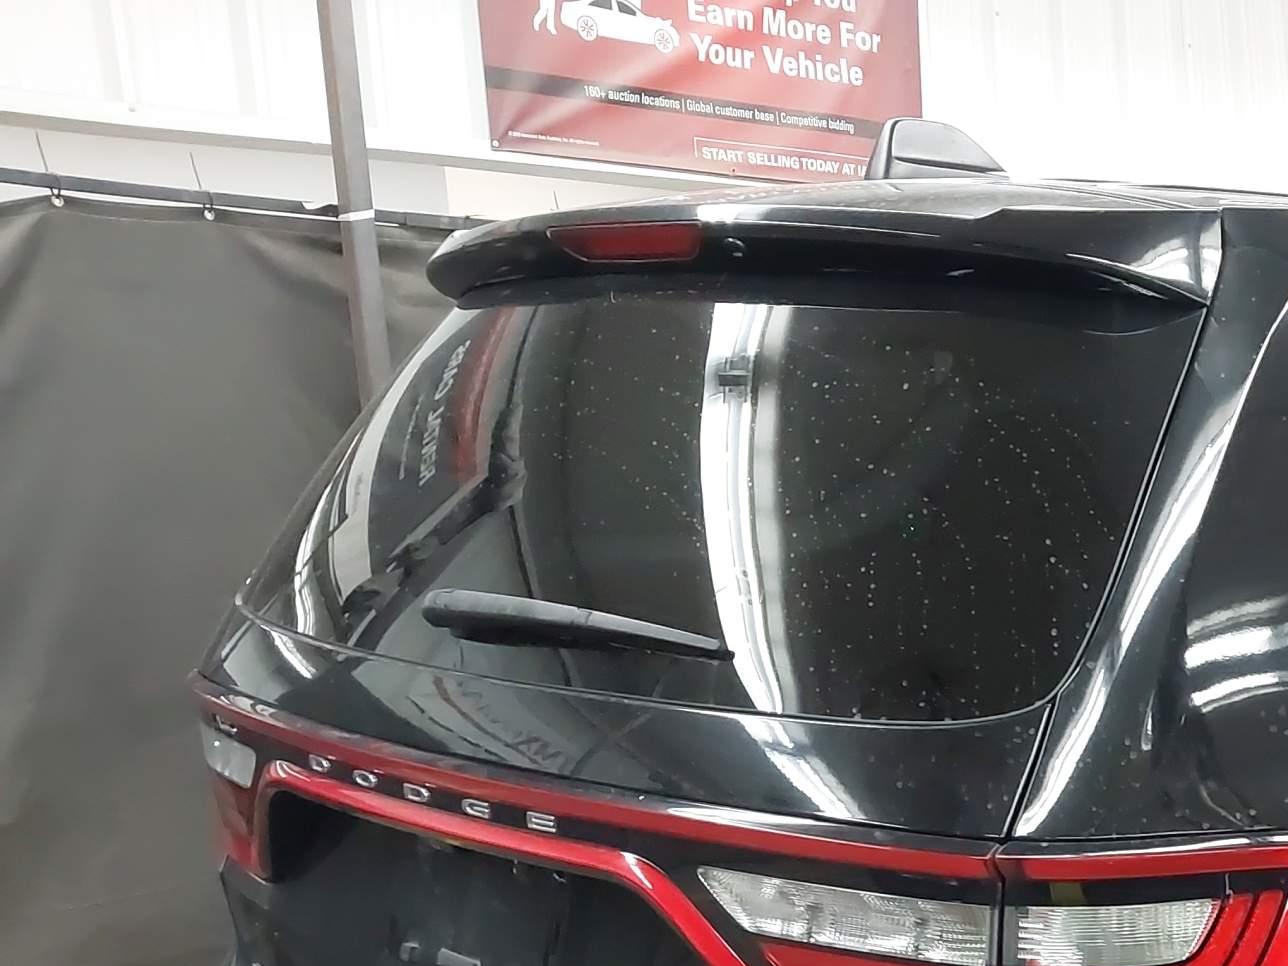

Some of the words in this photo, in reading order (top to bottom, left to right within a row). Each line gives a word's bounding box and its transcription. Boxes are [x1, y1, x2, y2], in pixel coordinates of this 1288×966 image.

[687, 0, 754, 31] Earn
[762, 6, 831, 45] More
[839, 21, 881, 53] For
[689, 32, 755, 69] Your
[761, 45, 864, 87] Vehicle
[608, 89, 640, 103] auction
[641, 92, 680, 110] locations
[686, 99, 714, 114] Global
[714, 105, 754, 120] customer
[754, 109, 775, 122] base
[780, 112, 828, 128] Competitive
[828, 117, 855, 135] bidding
[701, 146, 744, 164] START
[747, 151, 800, 170] SELLING
[800, 157, 841, 176] TODAY
[841, 163, 857, 176] AT
[308, 753, 557, 833] DODGE
